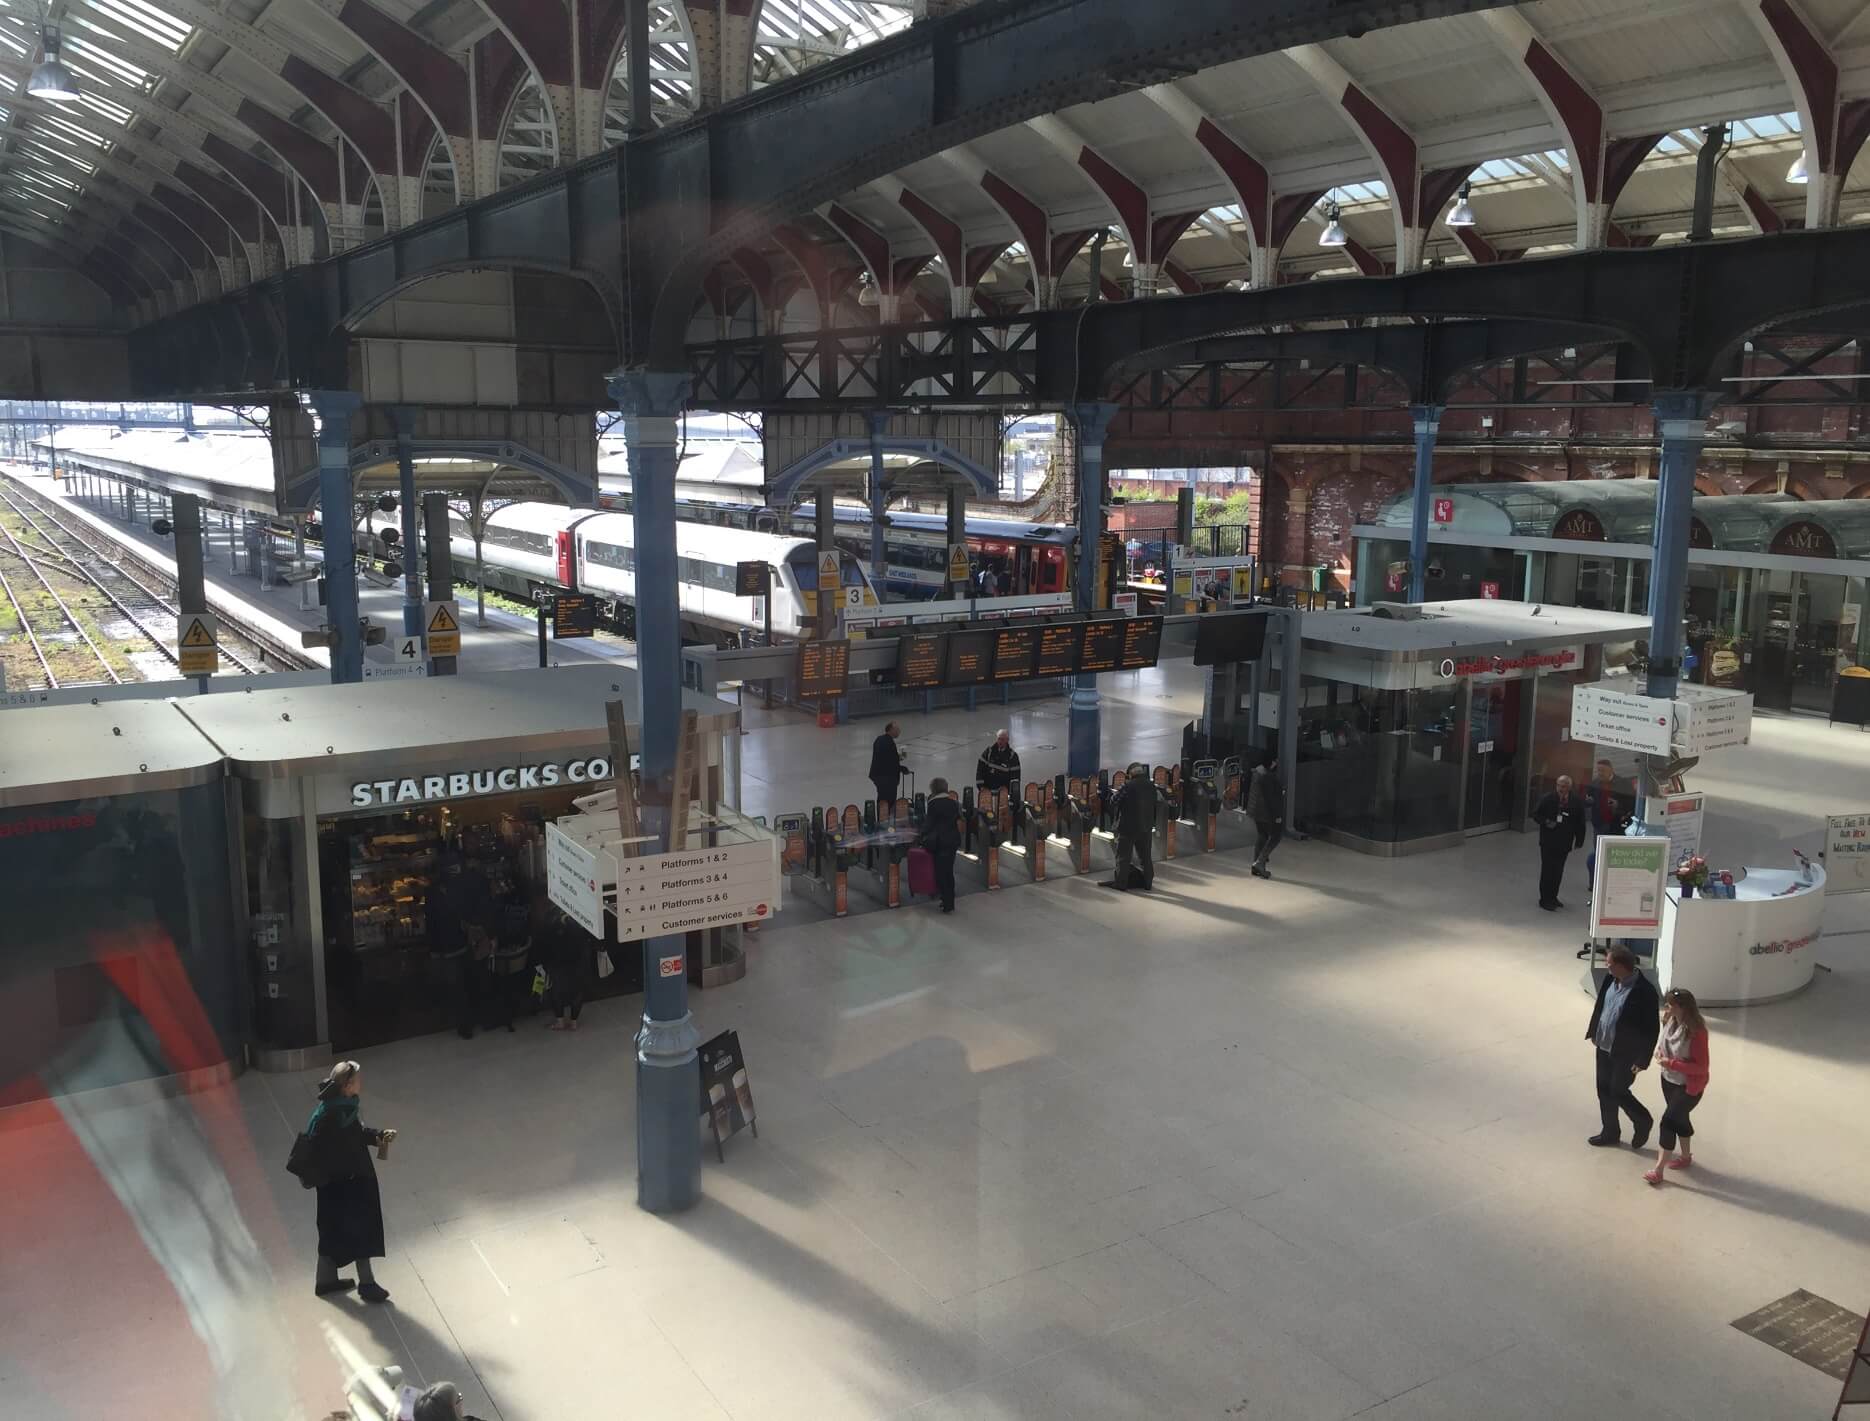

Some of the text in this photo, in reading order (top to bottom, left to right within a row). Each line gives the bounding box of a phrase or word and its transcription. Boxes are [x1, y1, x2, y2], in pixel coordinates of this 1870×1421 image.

[1566, 519, 1593, 534] AMT
[1785, 532, 1824, 550] AMT
[850, 588, 860, 604] 3
[402, 640, 416, 659] 4
[1598, 708, 1650, 722] Customer services
[1598, 722, 1615, 730] Ticket
[1597, 734, 1615, 742] Toilets
[1634, 741, 1658, 752] property
[352, 764, 558, 806] STARBUCKS
[1611, 847, 1631, 857] How
[1632, 847, 1645, 857] did
[661, 853, 728, 870] Platforms 1 & 2
[661, 873, 728, 890] Platforms 3 & 4
[662, 892, 728, 910] Platforms 5 & 6
[662, 911, 743, 930] Customer services
[1749, 941, 1785, 955] abellio
